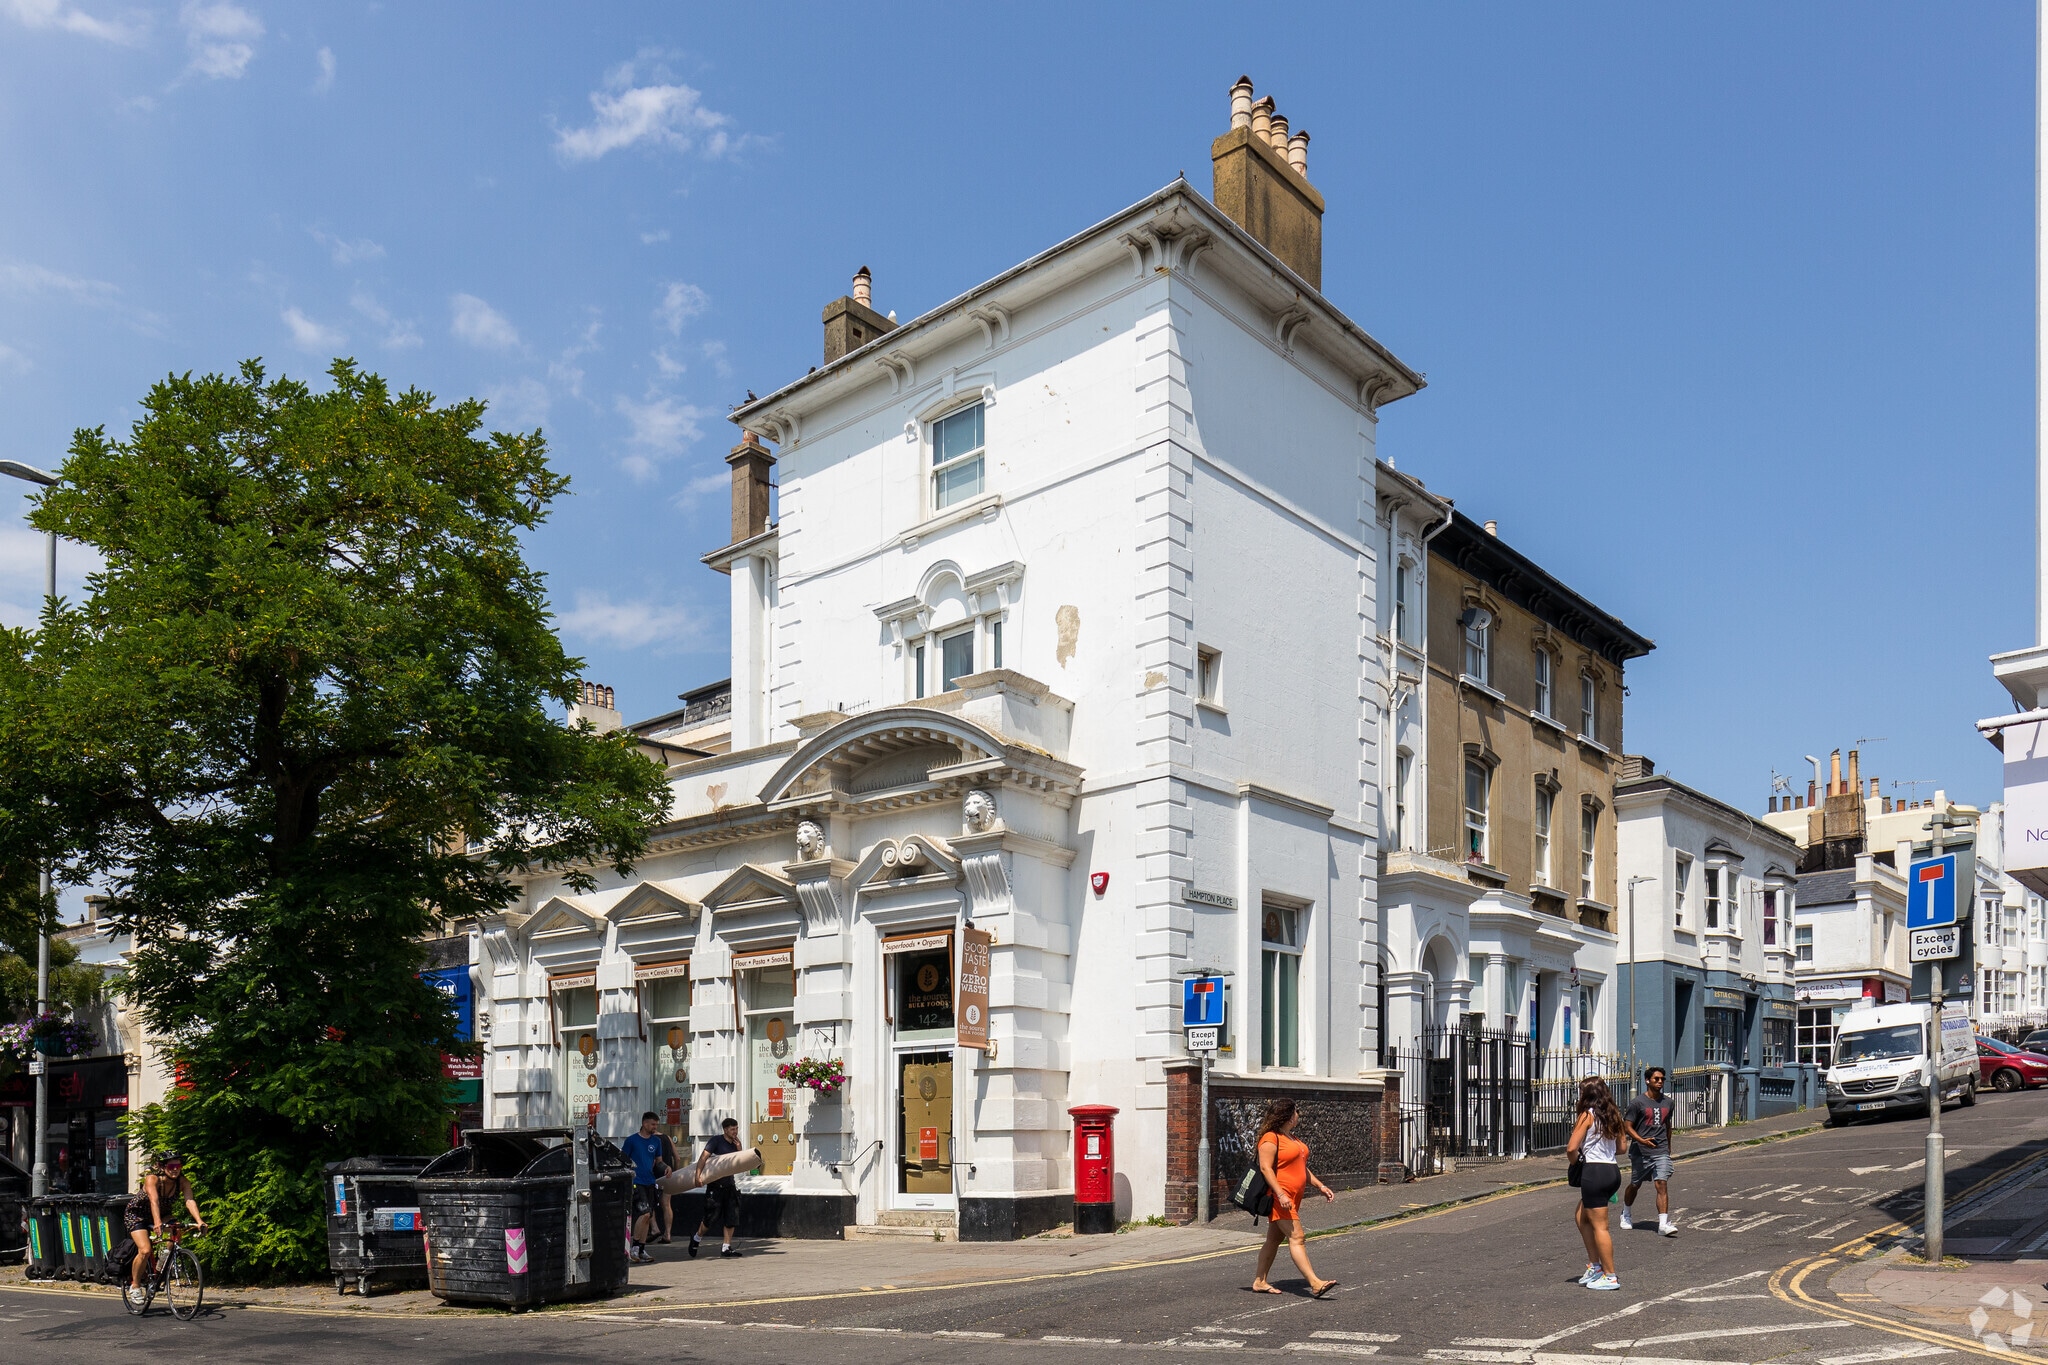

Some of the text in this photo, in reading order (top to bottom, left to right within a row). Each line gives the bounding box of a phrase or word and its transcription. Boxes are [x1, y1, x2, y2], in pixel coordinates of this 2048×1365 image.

[1188, 889, 1233, 907] HAMPTON PLACE
[1916, 931, 1956, 945] Except
[885, 937, 944, 952] Superfoods Organic
[964, 941, 988, 955] GOOD
[1917, 945, 1953, 957] cycles
[752, 958, 766, 966] Pasta
[771, 955, 788, 963] Snacks
[964, 952, 987, 967] TASTE
[973, 966, 978, 974] &
[962, 973, 987, 986] ZERO
[961, 983, 987, 995] WASTE
[1810, 984, 1835, 992] GENTS
[908, 993, 921, 1002] the
[908, 1001, 925, 1009] BULK
[918, 1013, 938, 1026] 142
[959, 1022, 969, 1030] the
[1191, 1031, 1215, 1039] Except
[759, 1043, 769, 1052] the
[1192, 1039, 1214, 1047] cycles
[462, 1063, 478, 1071] Repairs
[573, 1094, 594, 1103] GOOD
